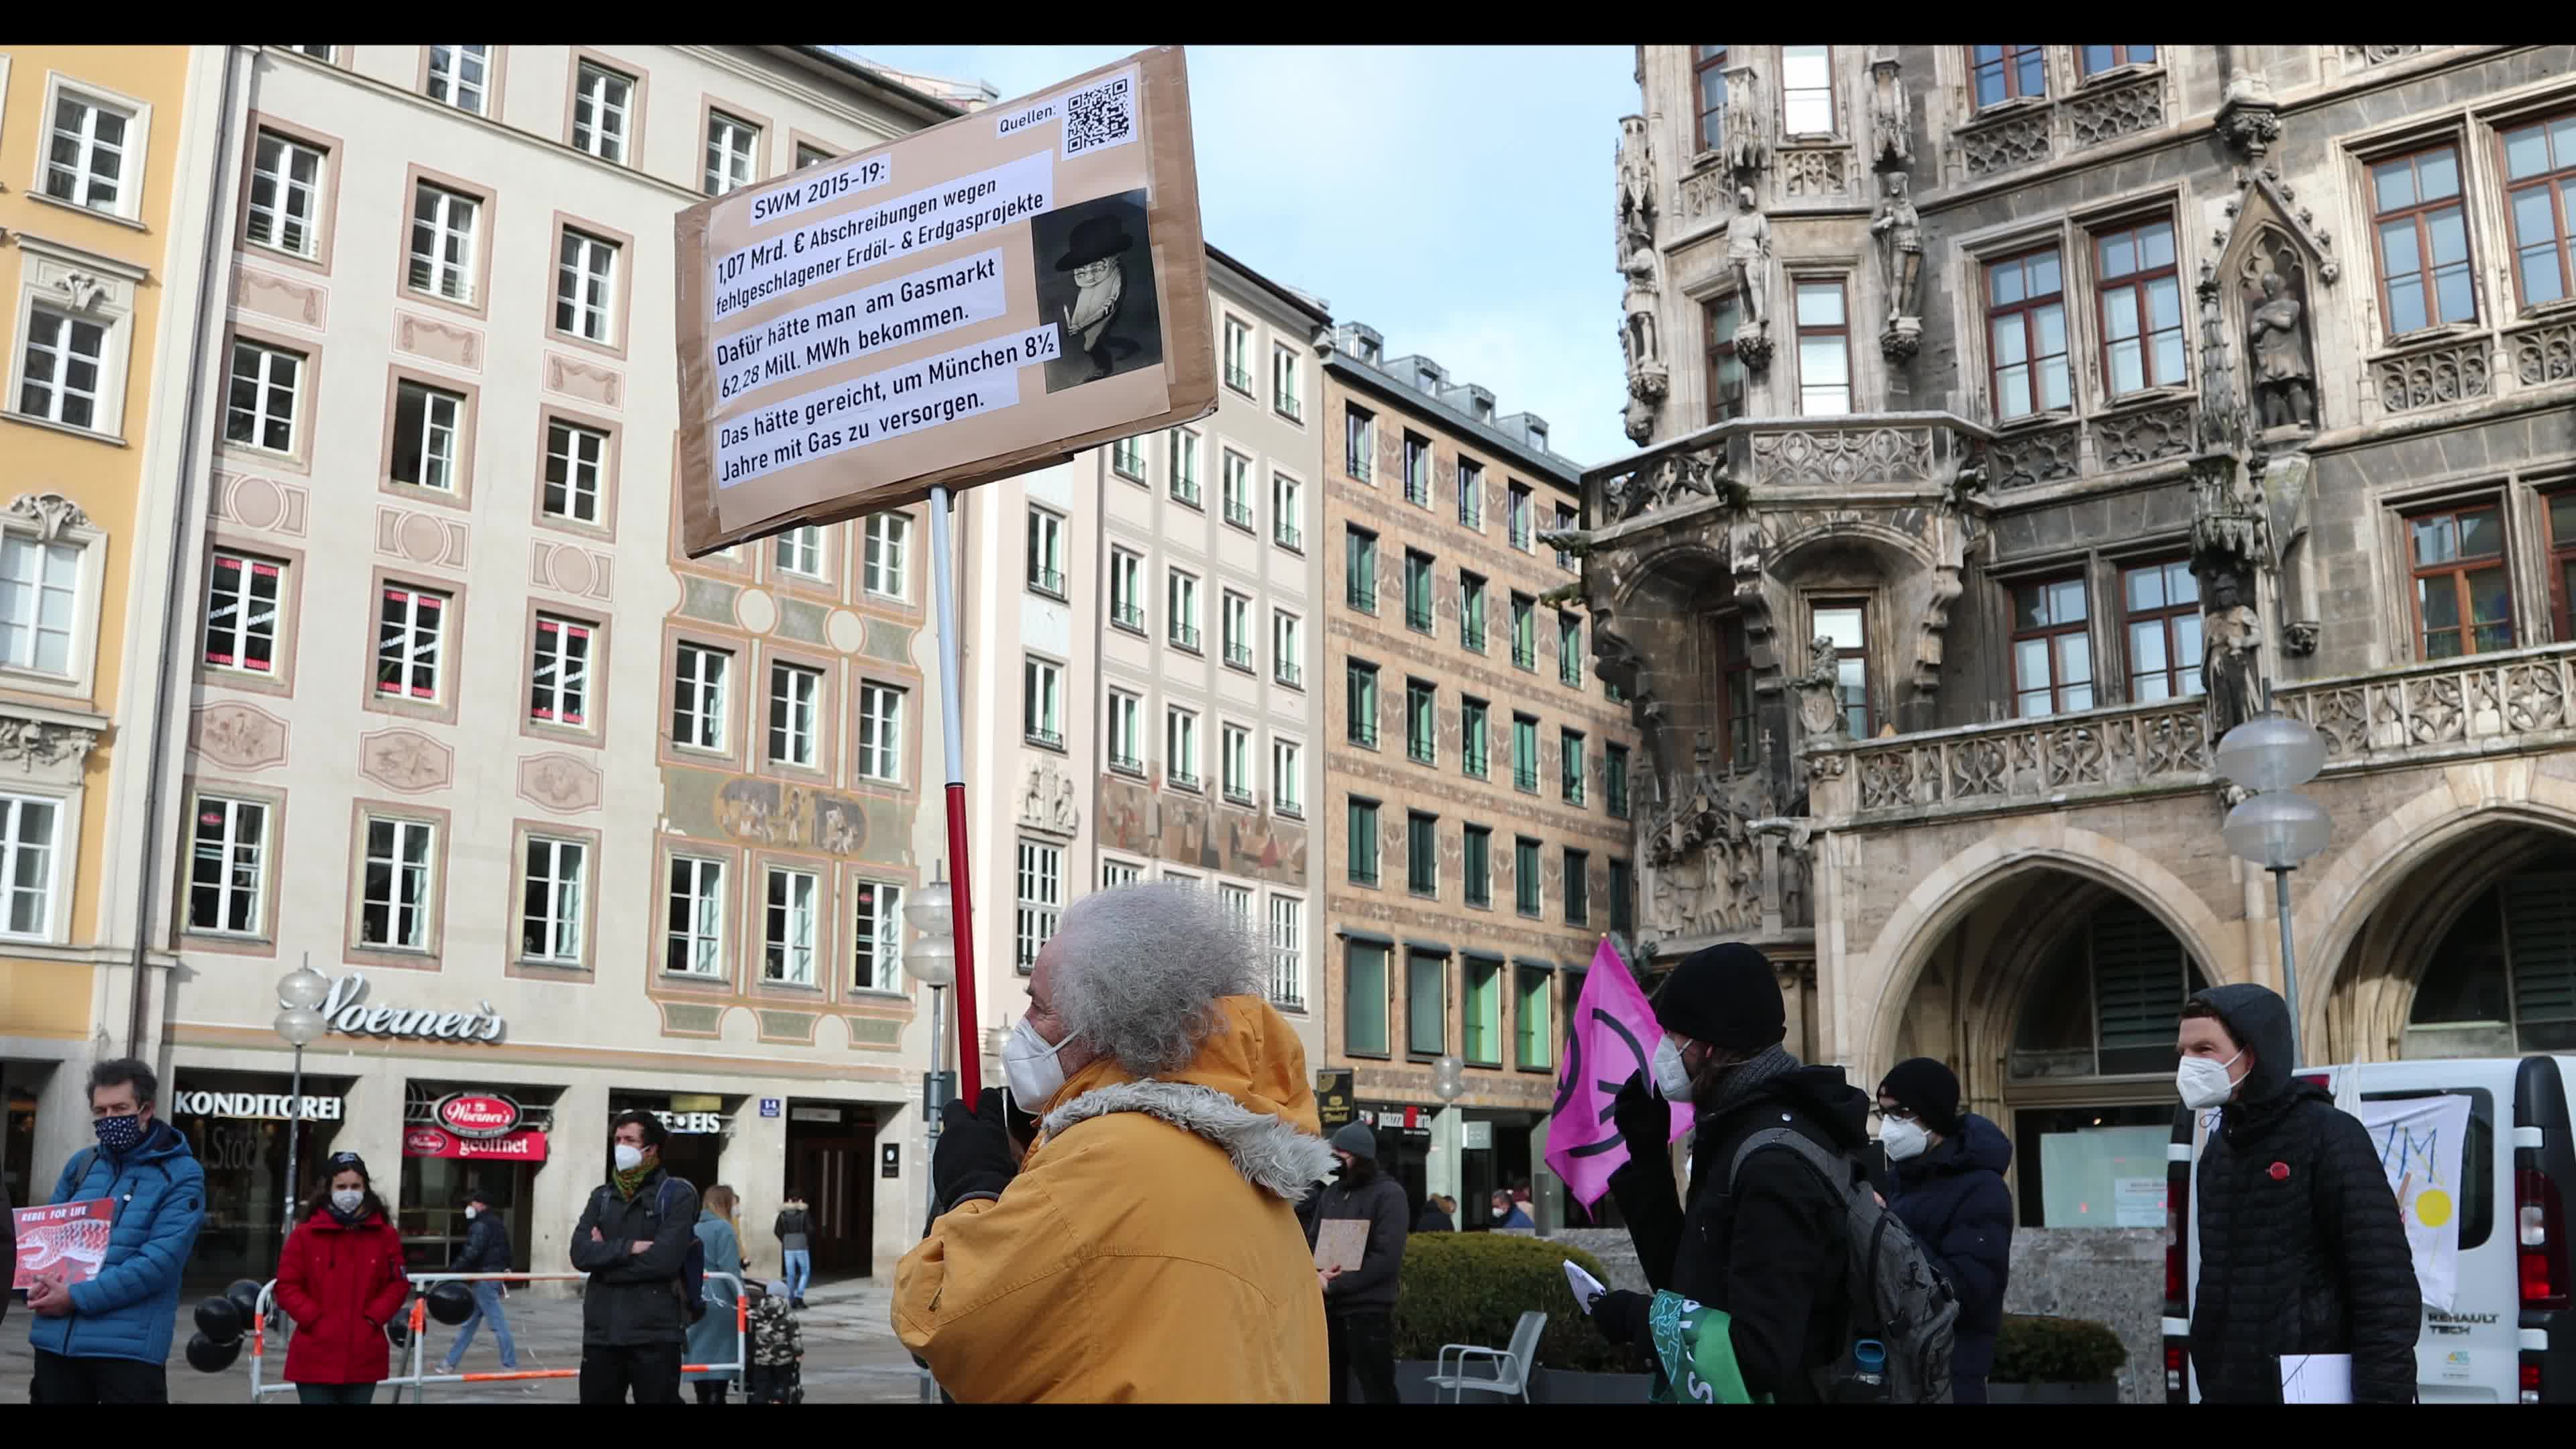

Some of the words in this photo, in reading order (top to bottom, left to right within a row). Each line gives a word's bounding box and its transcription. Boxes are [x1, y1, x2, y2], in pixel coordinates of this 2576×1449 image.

[1000, 105, 1057, 133] Quellen:
[755, 189, 800, 219] SWM
[808, 162, 885, 203] 2015-19:
[716, 256, 842, 315] fehlgeschlagener
[847, 238, 896, 267] Erdöl-
[901, 231, 913, 250] &
[918, 193, 1044, 246] Erdgasprojekte
[718, 253, 745, 286] 1,07
[751, 239, 788, 269] Mrd.
[794, 232, 805, 253] €
[810, 197, 937, 249] Abschreibungen
[944, 179, 996, 209] wegen
[717, 336, 763, 366] Dafür
[768, 317, 810, 346] hätte
[816, 304, 855, 329] man
[865, 292, 894, 314] am
[901, 258, 996, 303] Gasmarkt
[722, 365, 759, 398] 62,28
[765, 351, 801, 379] Mill.
[806, 336, 850, 366] MWh
[859, 305, 969, 350] bekommen.
[721, 425, 749, 449] Das
[754, 409, 798, 436] hätte
[805, 381, 886, 425] gereicht,
[893, 374, 922, 394] um
[928, 346, 1018, 384] München
[722, 453, 768, 482] Jahre
[774, 438, 802, 464] mit
[808, 430, 841, 453] Gas
[849, 423, 869, 442] zu
[879, 392, 985, 432] versorgen.
[174, 1091, 341, 1119] KONDITOREI
[688, 1112, 720, 1133] EIS
[21, 1212, 46, 1222] REBEL
[50, 1209, 66, 1220] FOR
[70, 1206, 87, 1217] LIFE
[2428, 1326, 2471, 1335] TECH
